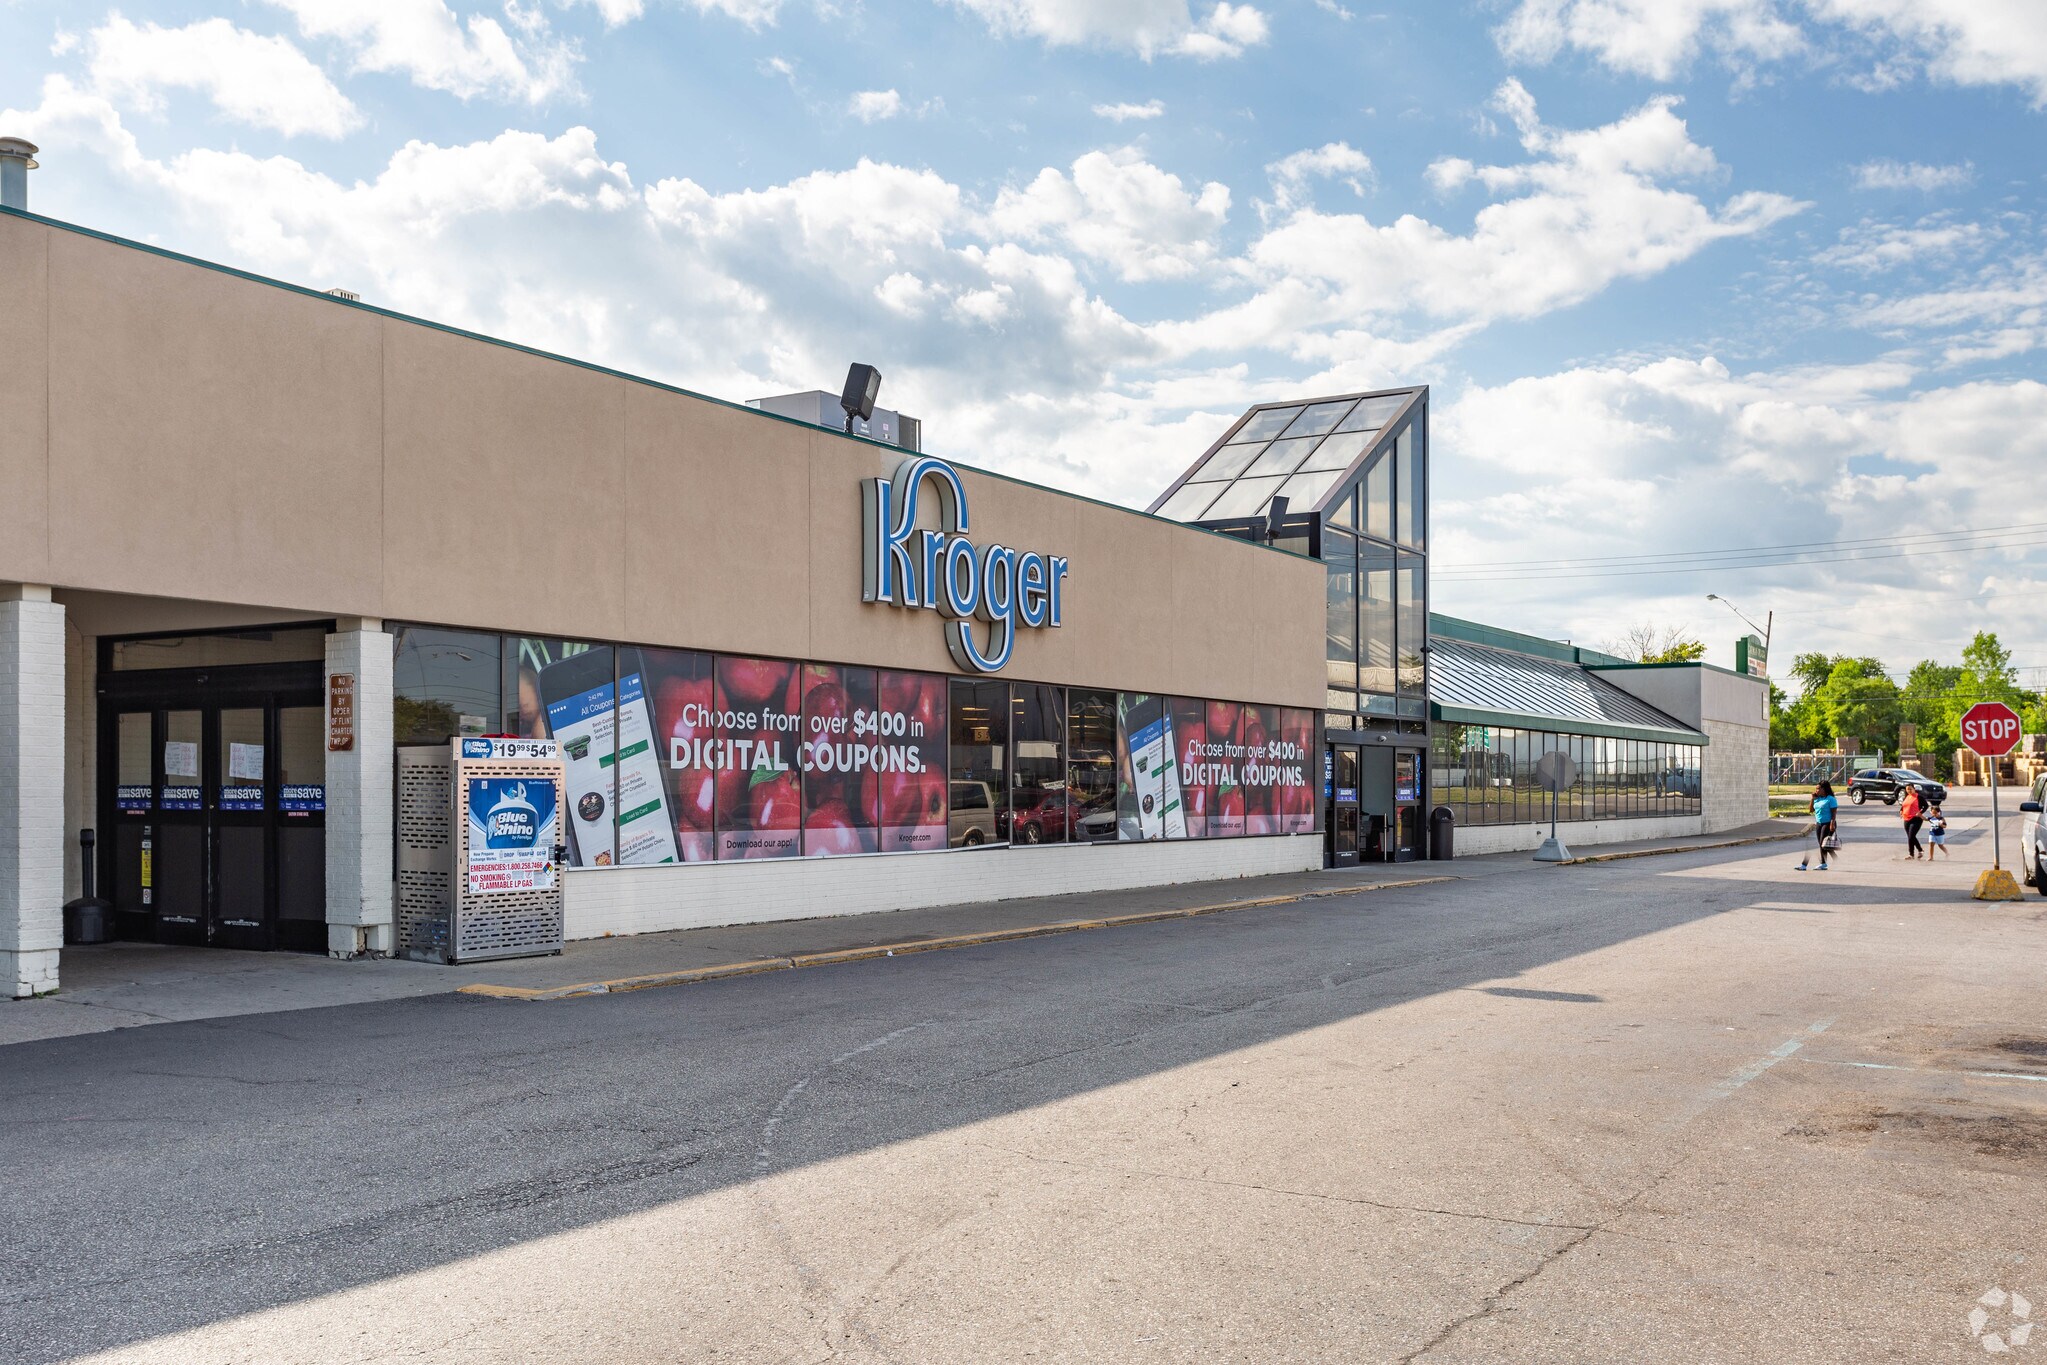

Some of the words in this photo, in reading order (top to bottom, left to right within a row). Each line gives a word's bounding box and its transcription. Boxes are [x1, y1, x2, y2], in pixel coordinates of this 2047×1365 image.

[862, 457, 1068, 673] Kroger
[331, 687, 353, 695] PARKING
[581, 704, 590, 716] All
[590, 698, 615, 713] Coupons
[619, 690, 641, 701] Categories
[333, 707, 351, 715] ORDER
[338, 717, 353, 725] FLINT
[682, 703, 757, 730] Choose
[762, 708, 802, 732] from
[811, 715, 848, 734] over
[853, 707, 906, 738] $400
[910, 716, 924, 738] in
[331, 727, 353, 735] CHARTER
[1965, 718, 2017, 741] STOP
[670, 737, 789, 771] DIGITAL
[796, 743, 927, 774] COUPONS.
[1188, 739, 1223, 756] Choose
[1225, 741, 1245, 758] from
[1247, 746, 1266, 759] over
[1268, 740, 1295, 761] $400
[1297, 745, 1304, 760] in
[1182, 763, 1238, 785] DIGITAL
[1241, 764, 1305, 786] COUPONS.
[130, 787, 152, 798] save
[176, 788, 199, 799] save
[237, 788, 261, 799] save
[297, 787, 322, 798] save
[497, 811, 528, 823] Blue
[493, 823, 534, 836] Rhino
[898, 832, 932, 843] Kroger.com
[726, 838, 763, 849] Download
[763, 840, 775, 848] our
[776, 838, 793, 850] app!
[470, 875, 479, 883] NO
[479, 873, 506, 882] SMOKING
[479, 880, 513, 890] FLAMMABLE
[514, 880, 521, 888] LP
[521, 879, 533, 887] GAS
